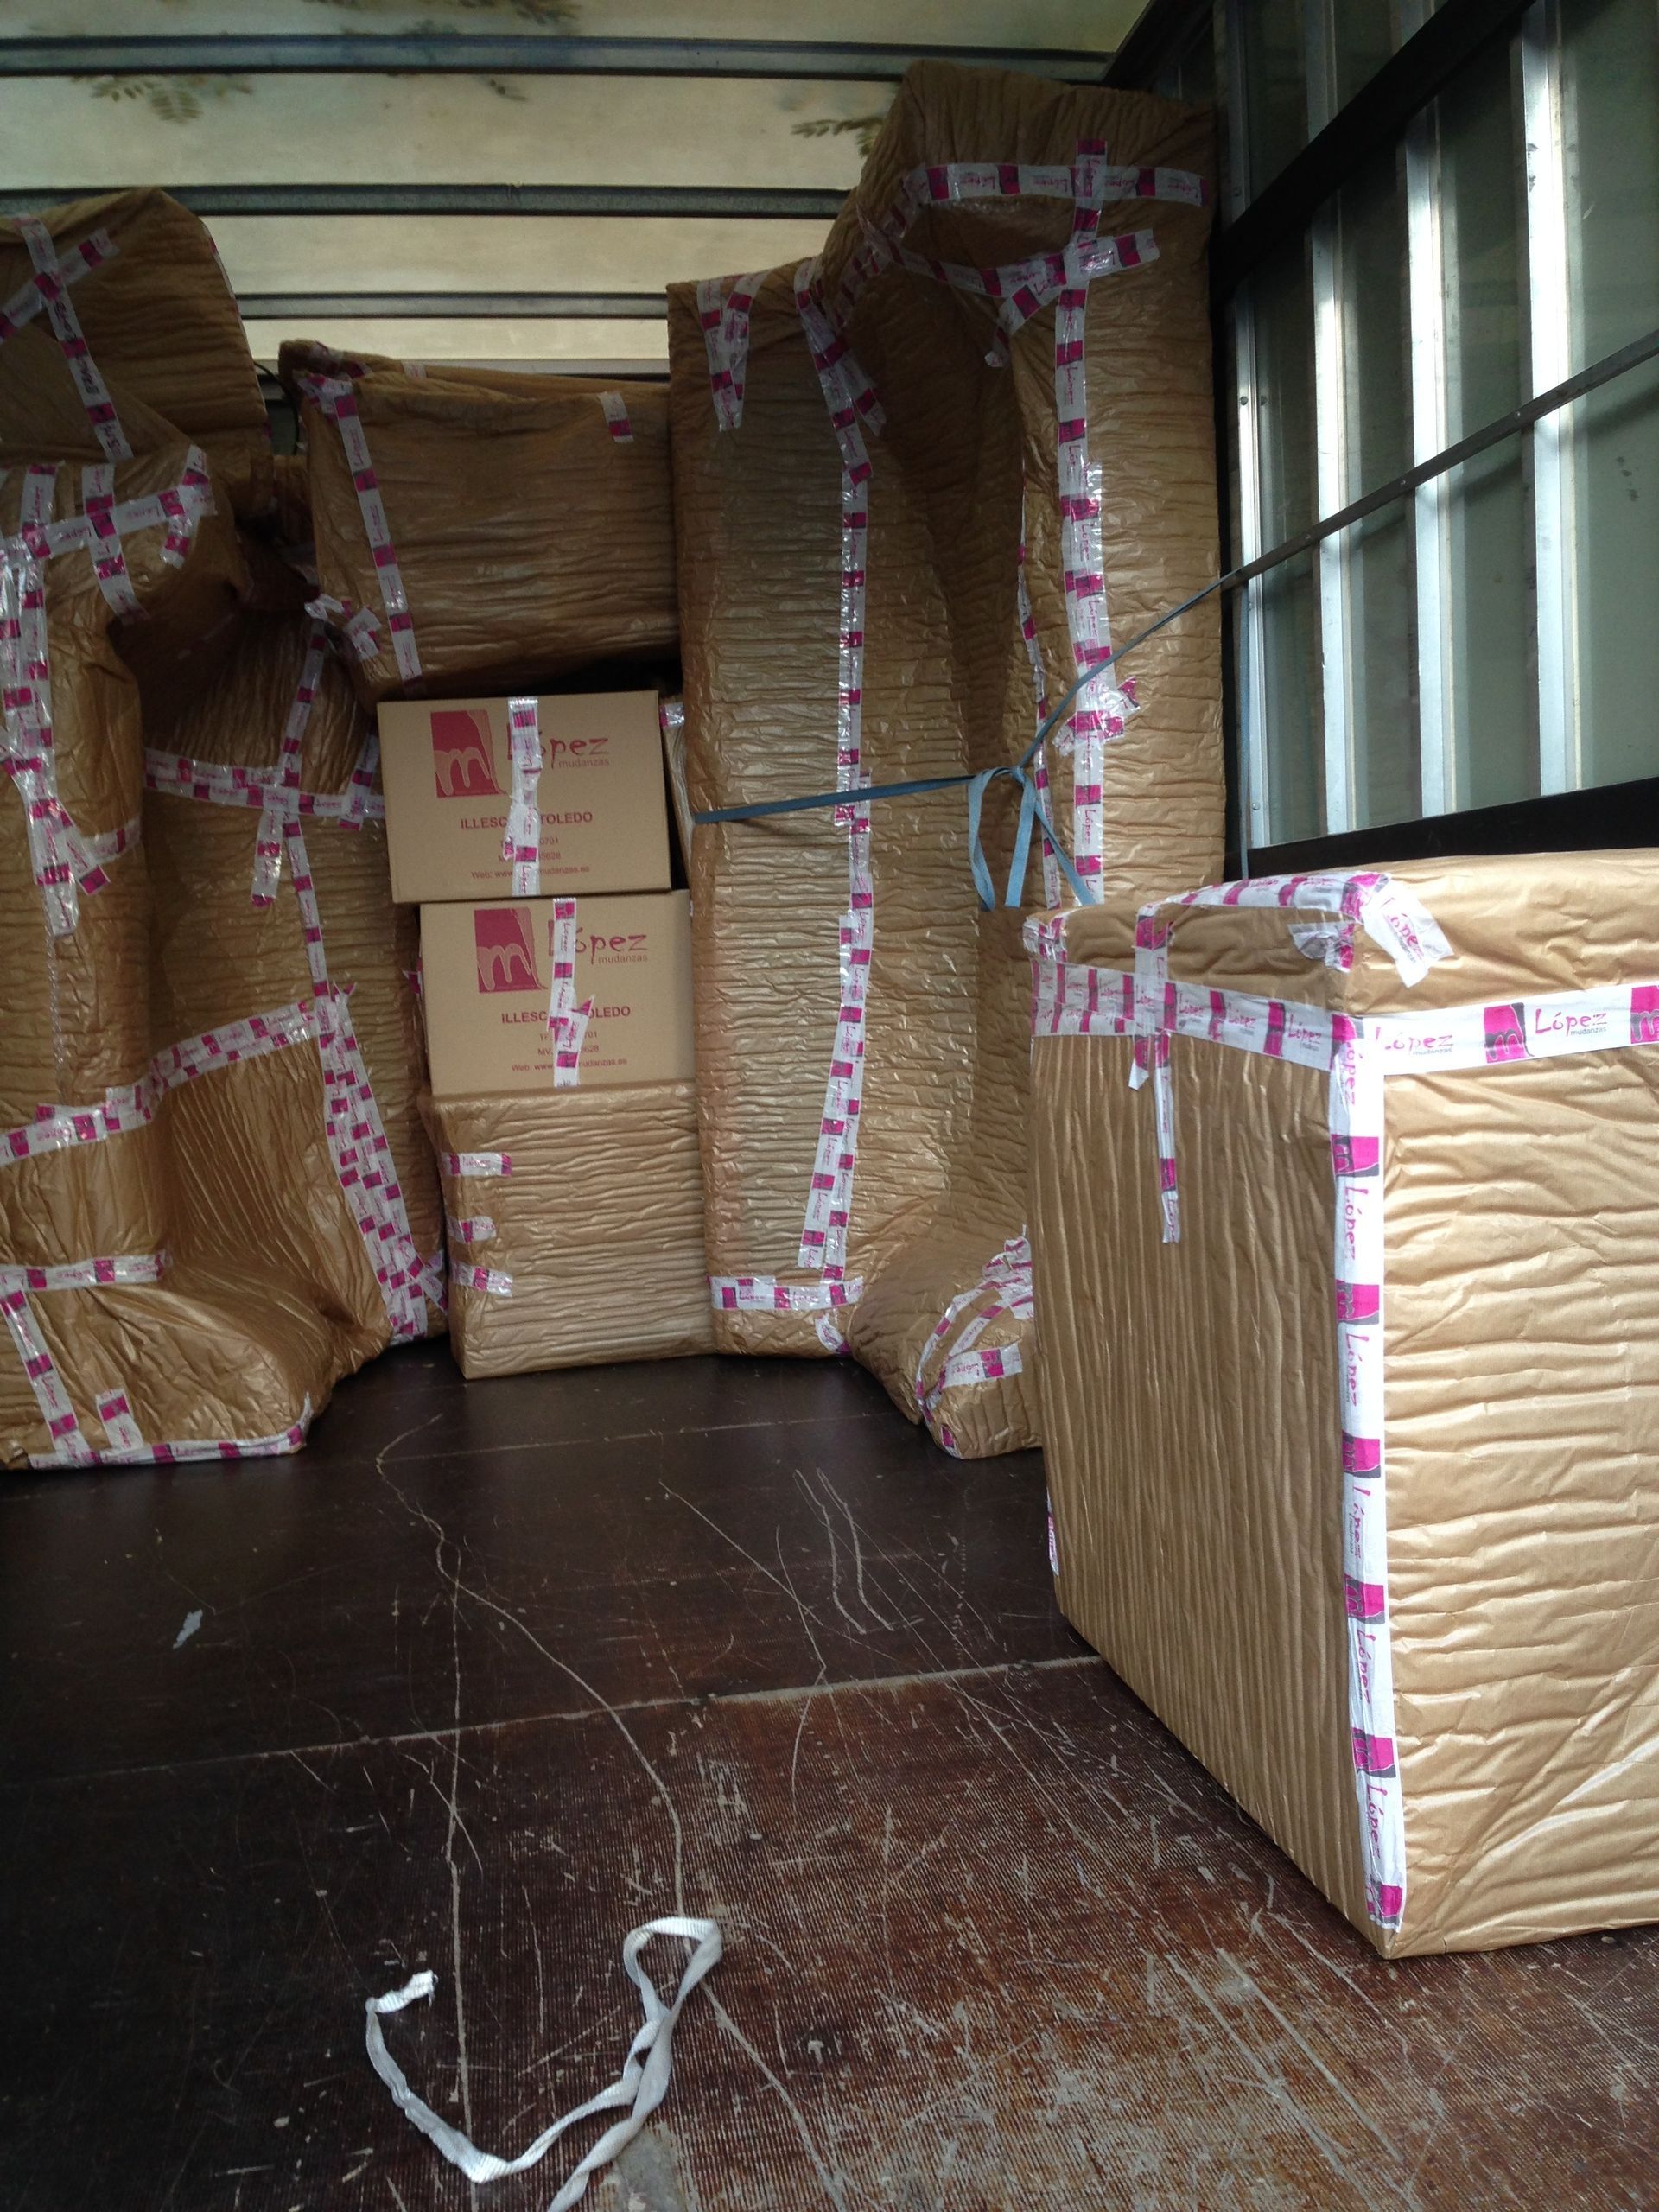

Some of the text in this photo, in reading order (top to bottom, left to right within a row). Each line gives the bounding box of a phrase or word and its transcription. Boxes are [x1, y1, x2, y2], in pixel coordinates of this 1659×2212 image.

[507, 722, 610, 769] pez
[558, 757, 610, 769] mudanzas
[461, 817, 508, 830] ILLESC
[540, 810, 594, 824] TOLEDO
[598, 954, 648, 965] mudanzas
[502, 1010, 546, 1023] ILLESC
[1288, 1013, 1322, 1046] López
[1535, 1009, 1607, 1037] López
[1570, 1026, 1607, 1036] mudanzas
[1342, 1042, 1363, 1105] ópez
[1344, 1185, 1370, 1261] López
[1345, 1333, 1370, 1408] López
[1357, 1628, 1376, 1705] López
[1366, 1783, 1389, 1859] López
